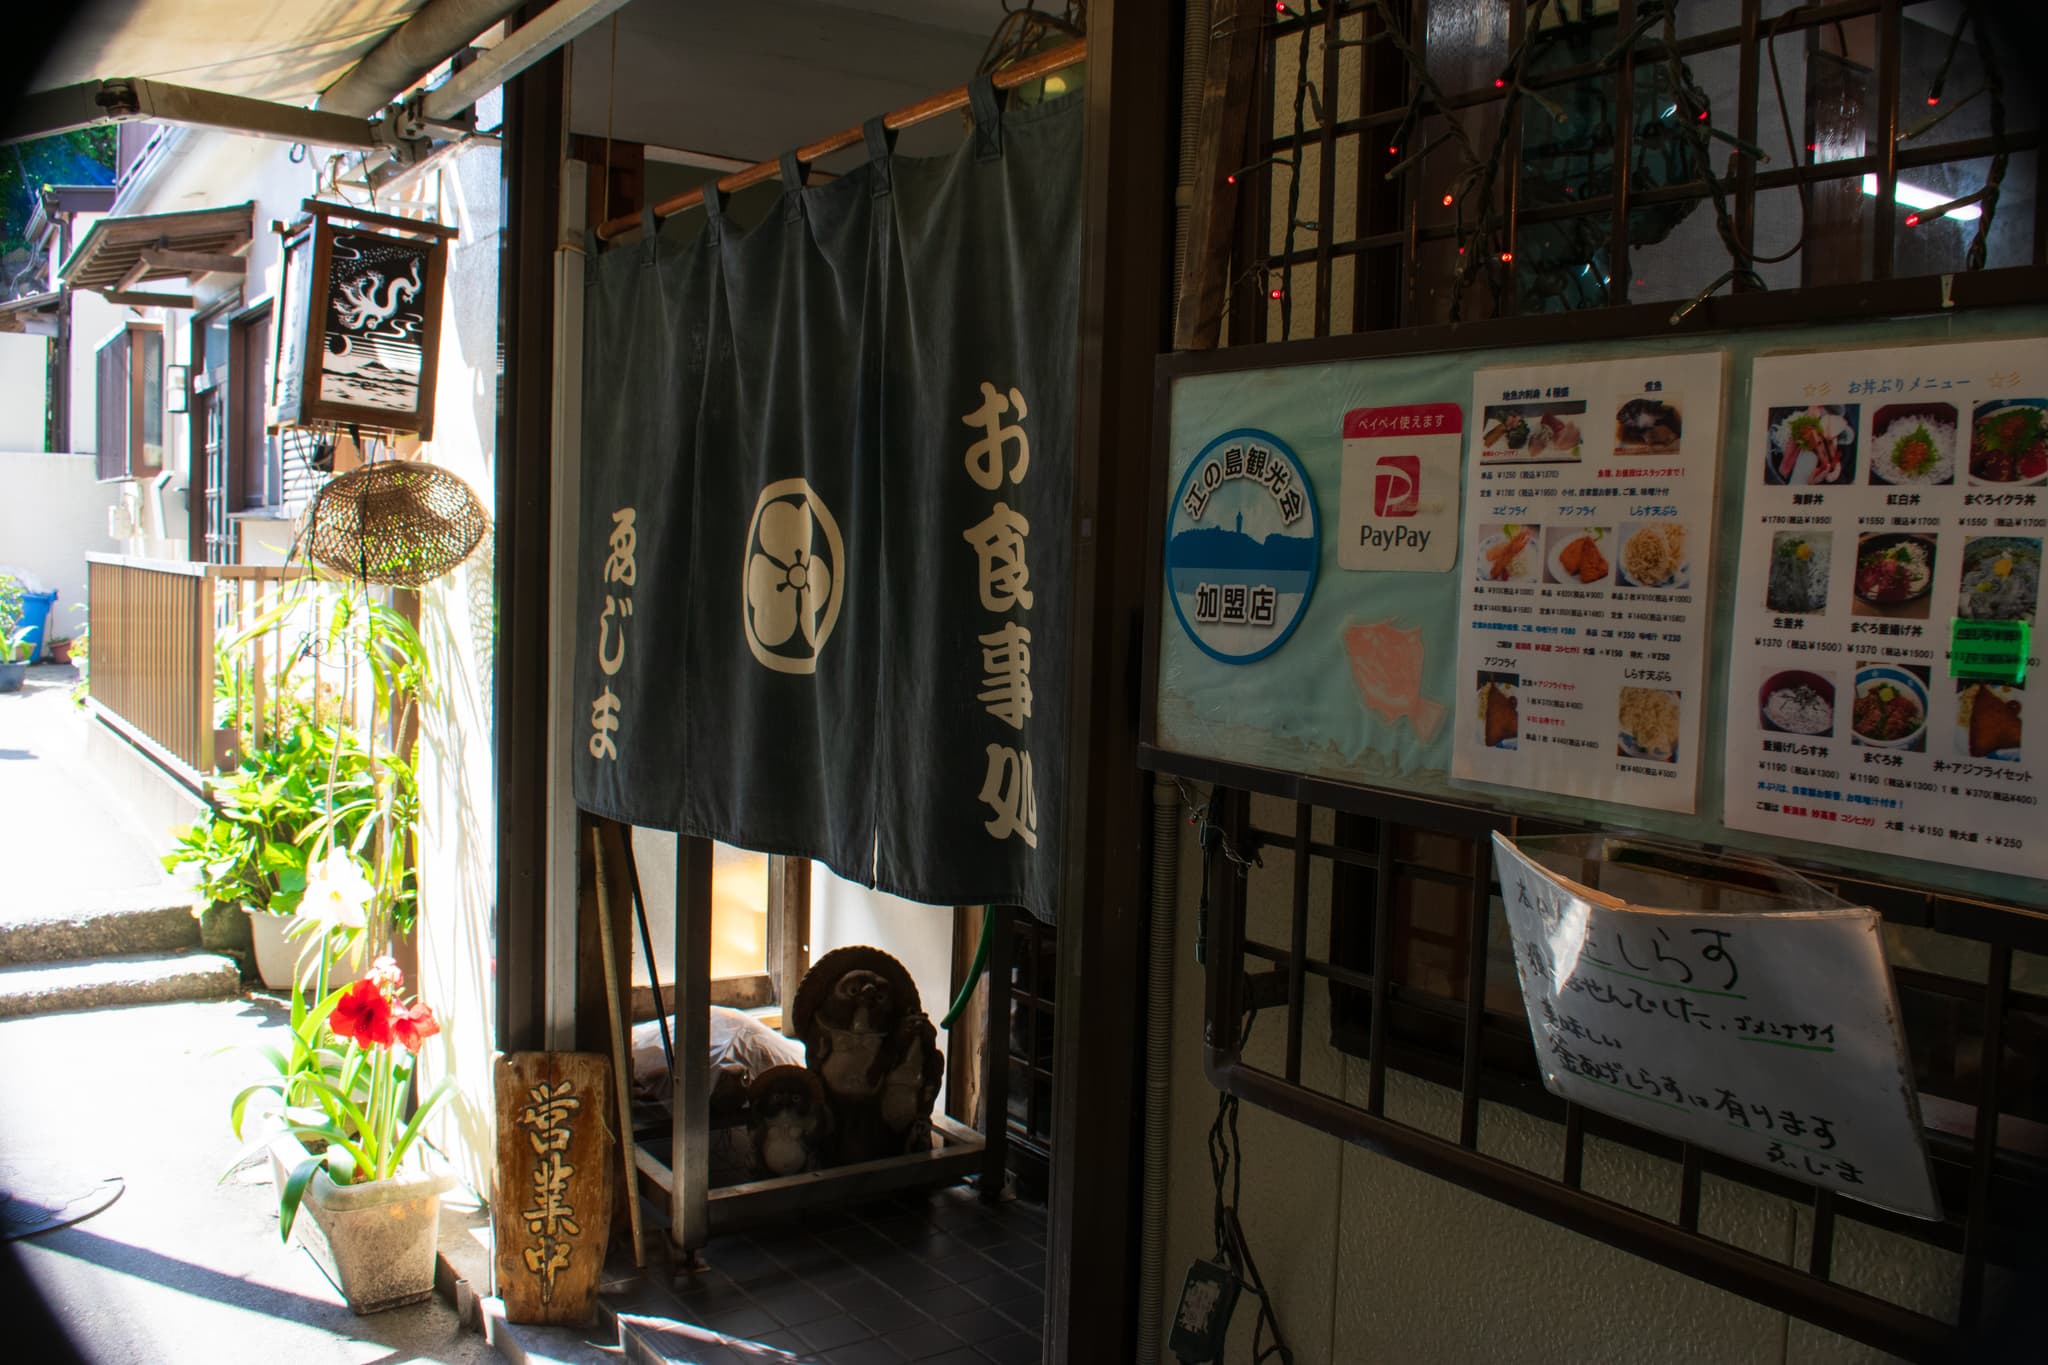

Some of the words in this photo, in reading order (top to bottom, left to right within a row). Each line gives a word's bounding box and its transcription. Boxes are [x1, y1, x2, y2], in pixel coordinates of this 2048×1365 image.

[1847, 377, 1971, 395] お丼ぶりメニュー
[1184, 446, 1302, 521] 江の島観光会
[1792, 493, 1824, 506] 海鮮丼
[1886, 494, 1921, 506] 紅白丼
[1964, 493, 2036, 506] まぐろイクラ丼
[1629, 504, 1678, 517] しらす天ぷら
[1360, 525, 1431, 552] PayPay
[1197, 585, 1274, 621] 加盟店
[961, 381, 1038, 849] お食事処
[1483, 655, 1519, 669] アジフライ
[1623, 668, 1673, 684] しらす天ぷら
[1863, 751, 1904, 768] まぐろ丼
[518, 1079, 581, 1305] 営業中
